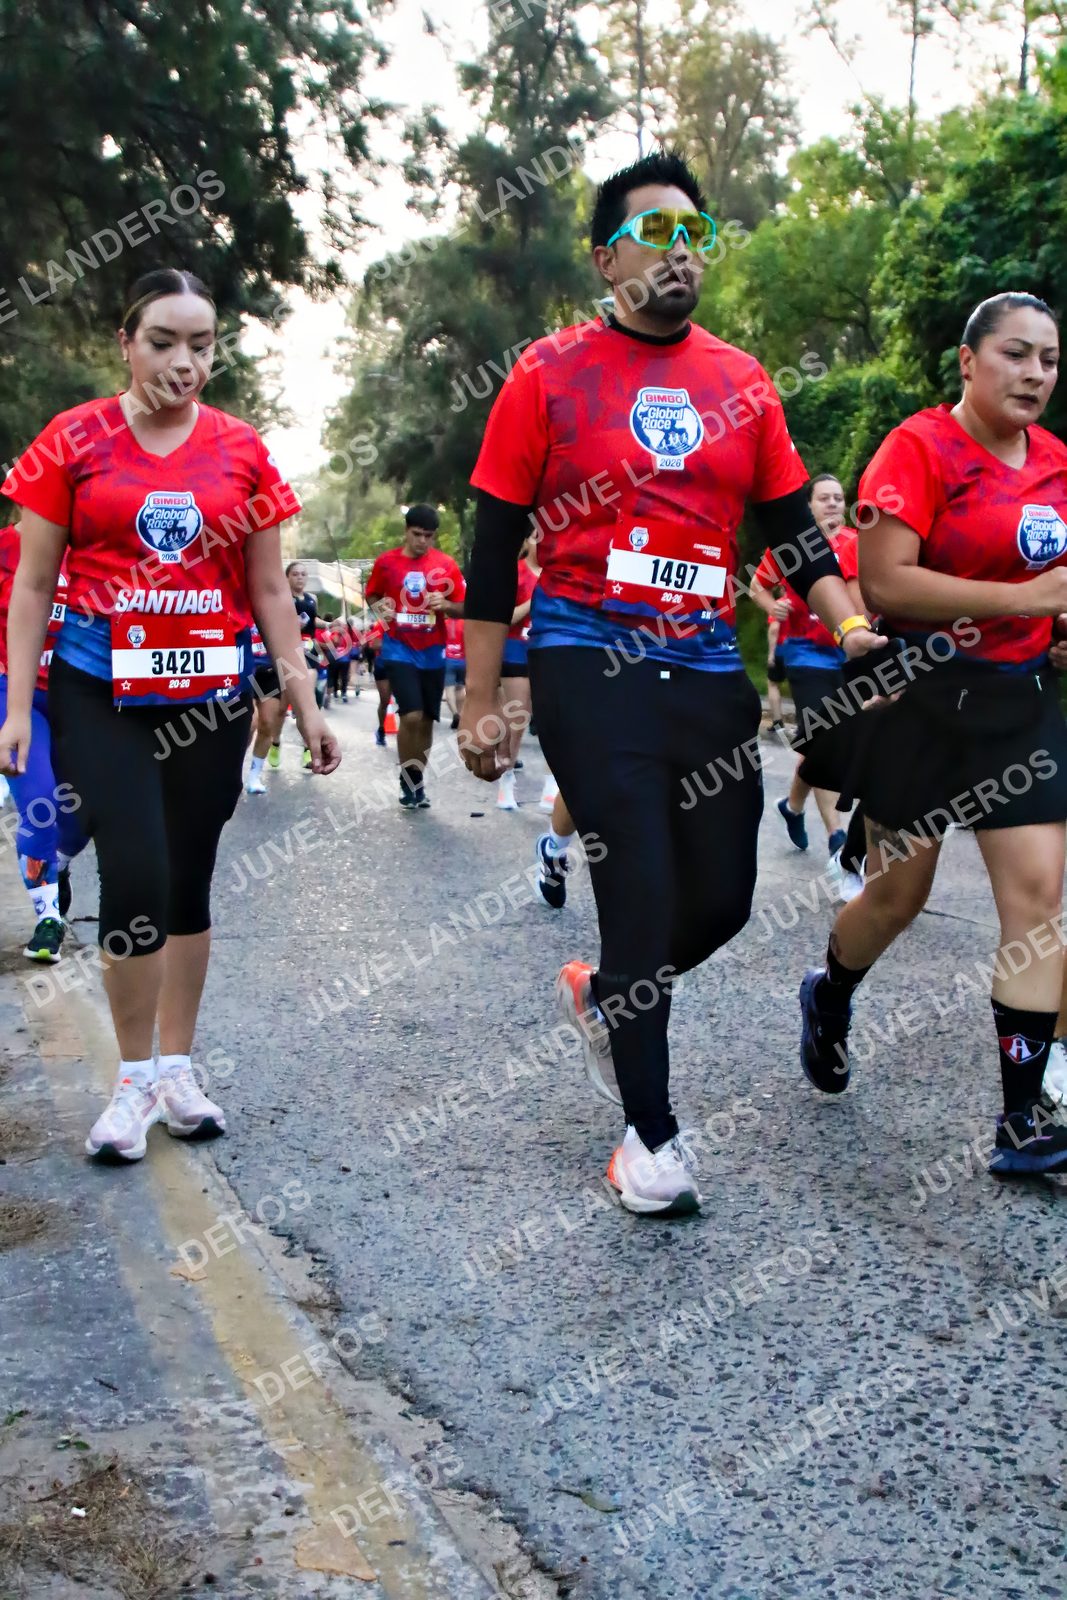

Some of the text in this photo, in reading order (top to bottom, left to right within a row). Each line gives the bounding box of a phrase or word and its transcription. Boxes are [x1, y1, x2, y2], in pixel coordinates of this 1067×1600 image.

[645, 394, 683, 403] BIMBO
[648, 406, 684, 420] Global
[642, 416, 672, 430] Race
[154, 508, 188, 520] Global
[146, 519, 174, 528] Race
[1026, 530, 1048, 540] Race
[651, 559, 698, 590] 1497
[114, 588, 223, 614] SANTIAGO
[152, 650, 205, 675] 3420
